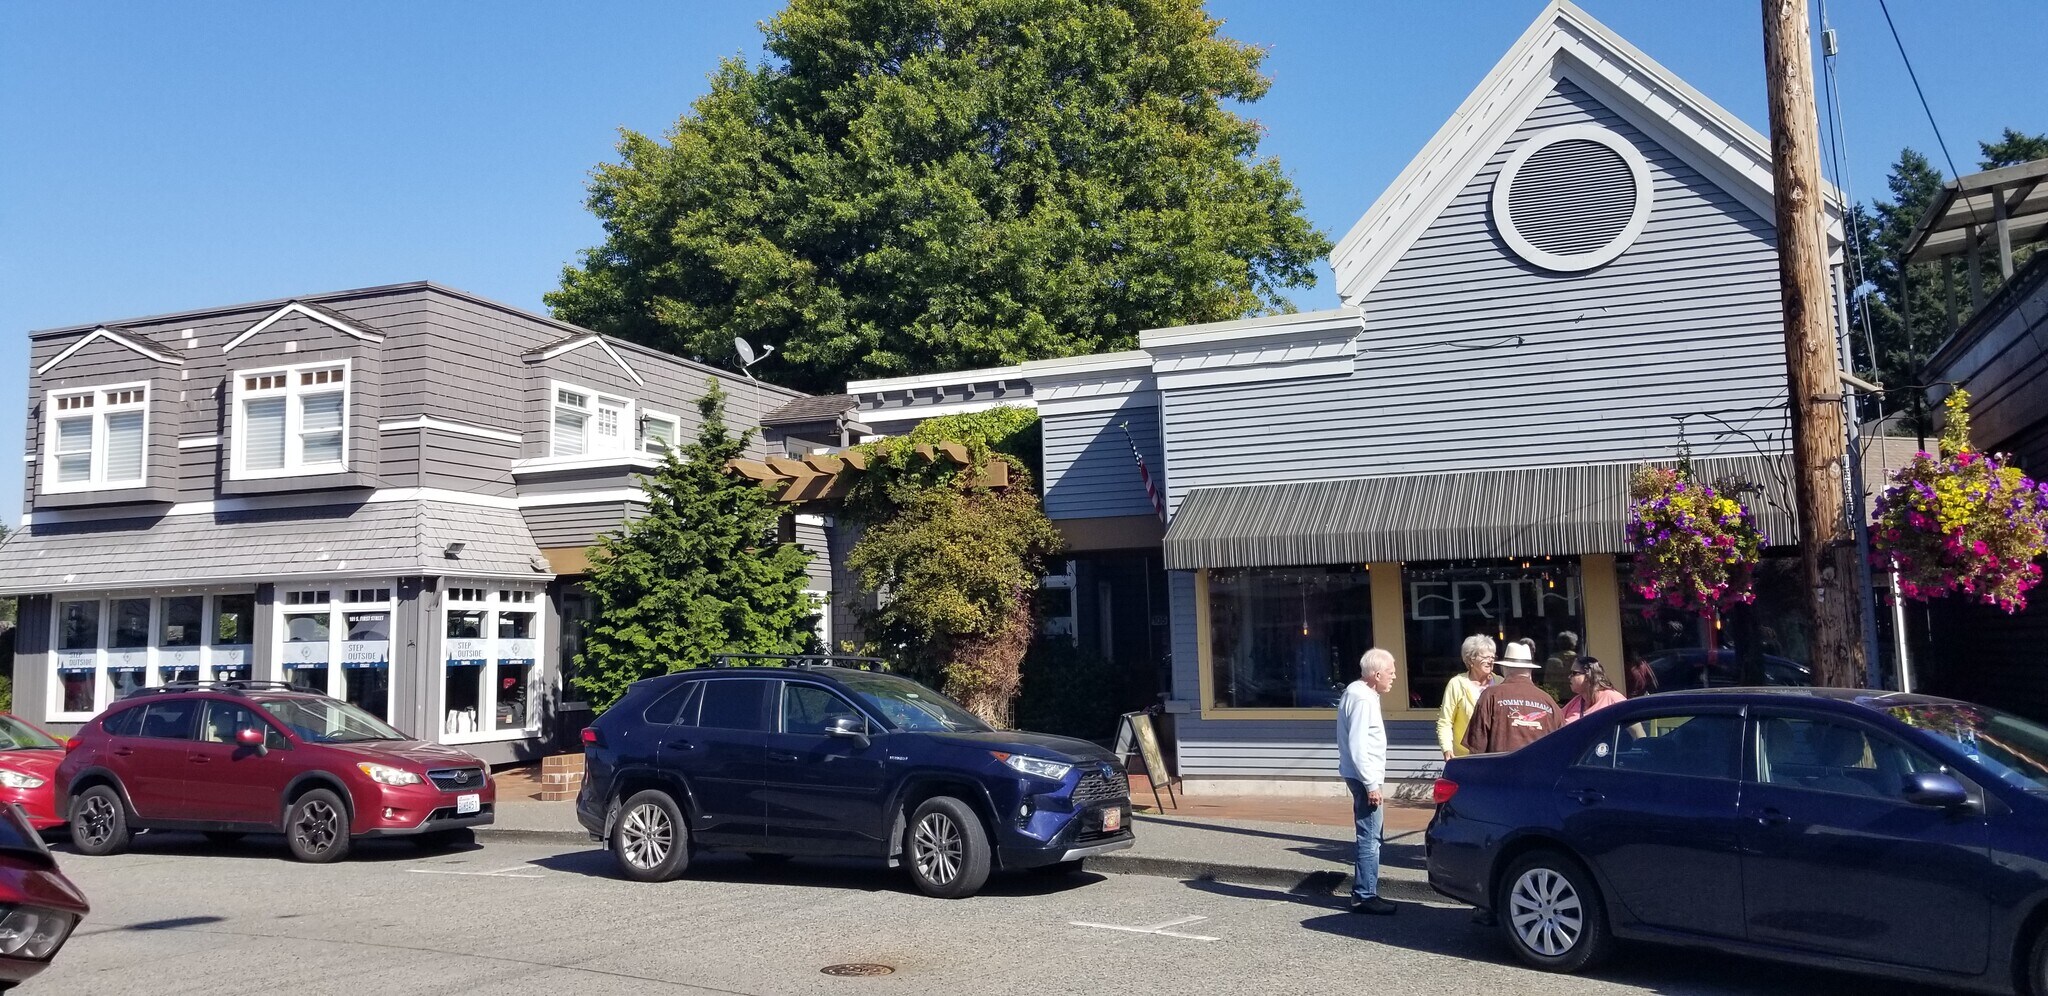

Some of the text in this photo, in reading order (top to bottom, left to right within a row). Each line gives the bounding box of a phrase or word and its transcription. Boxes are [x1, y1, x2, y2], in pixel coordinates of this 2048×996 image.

[1410, 576, 1580, 620] ERTH
[348, 644, 364, 652] STEP
[348, 652, 376, 660] OUTSIDE
[457, 650, 482, 658] OUTSIDE
[1497, 699, 1553, 714] TOMMY BAHAMA
